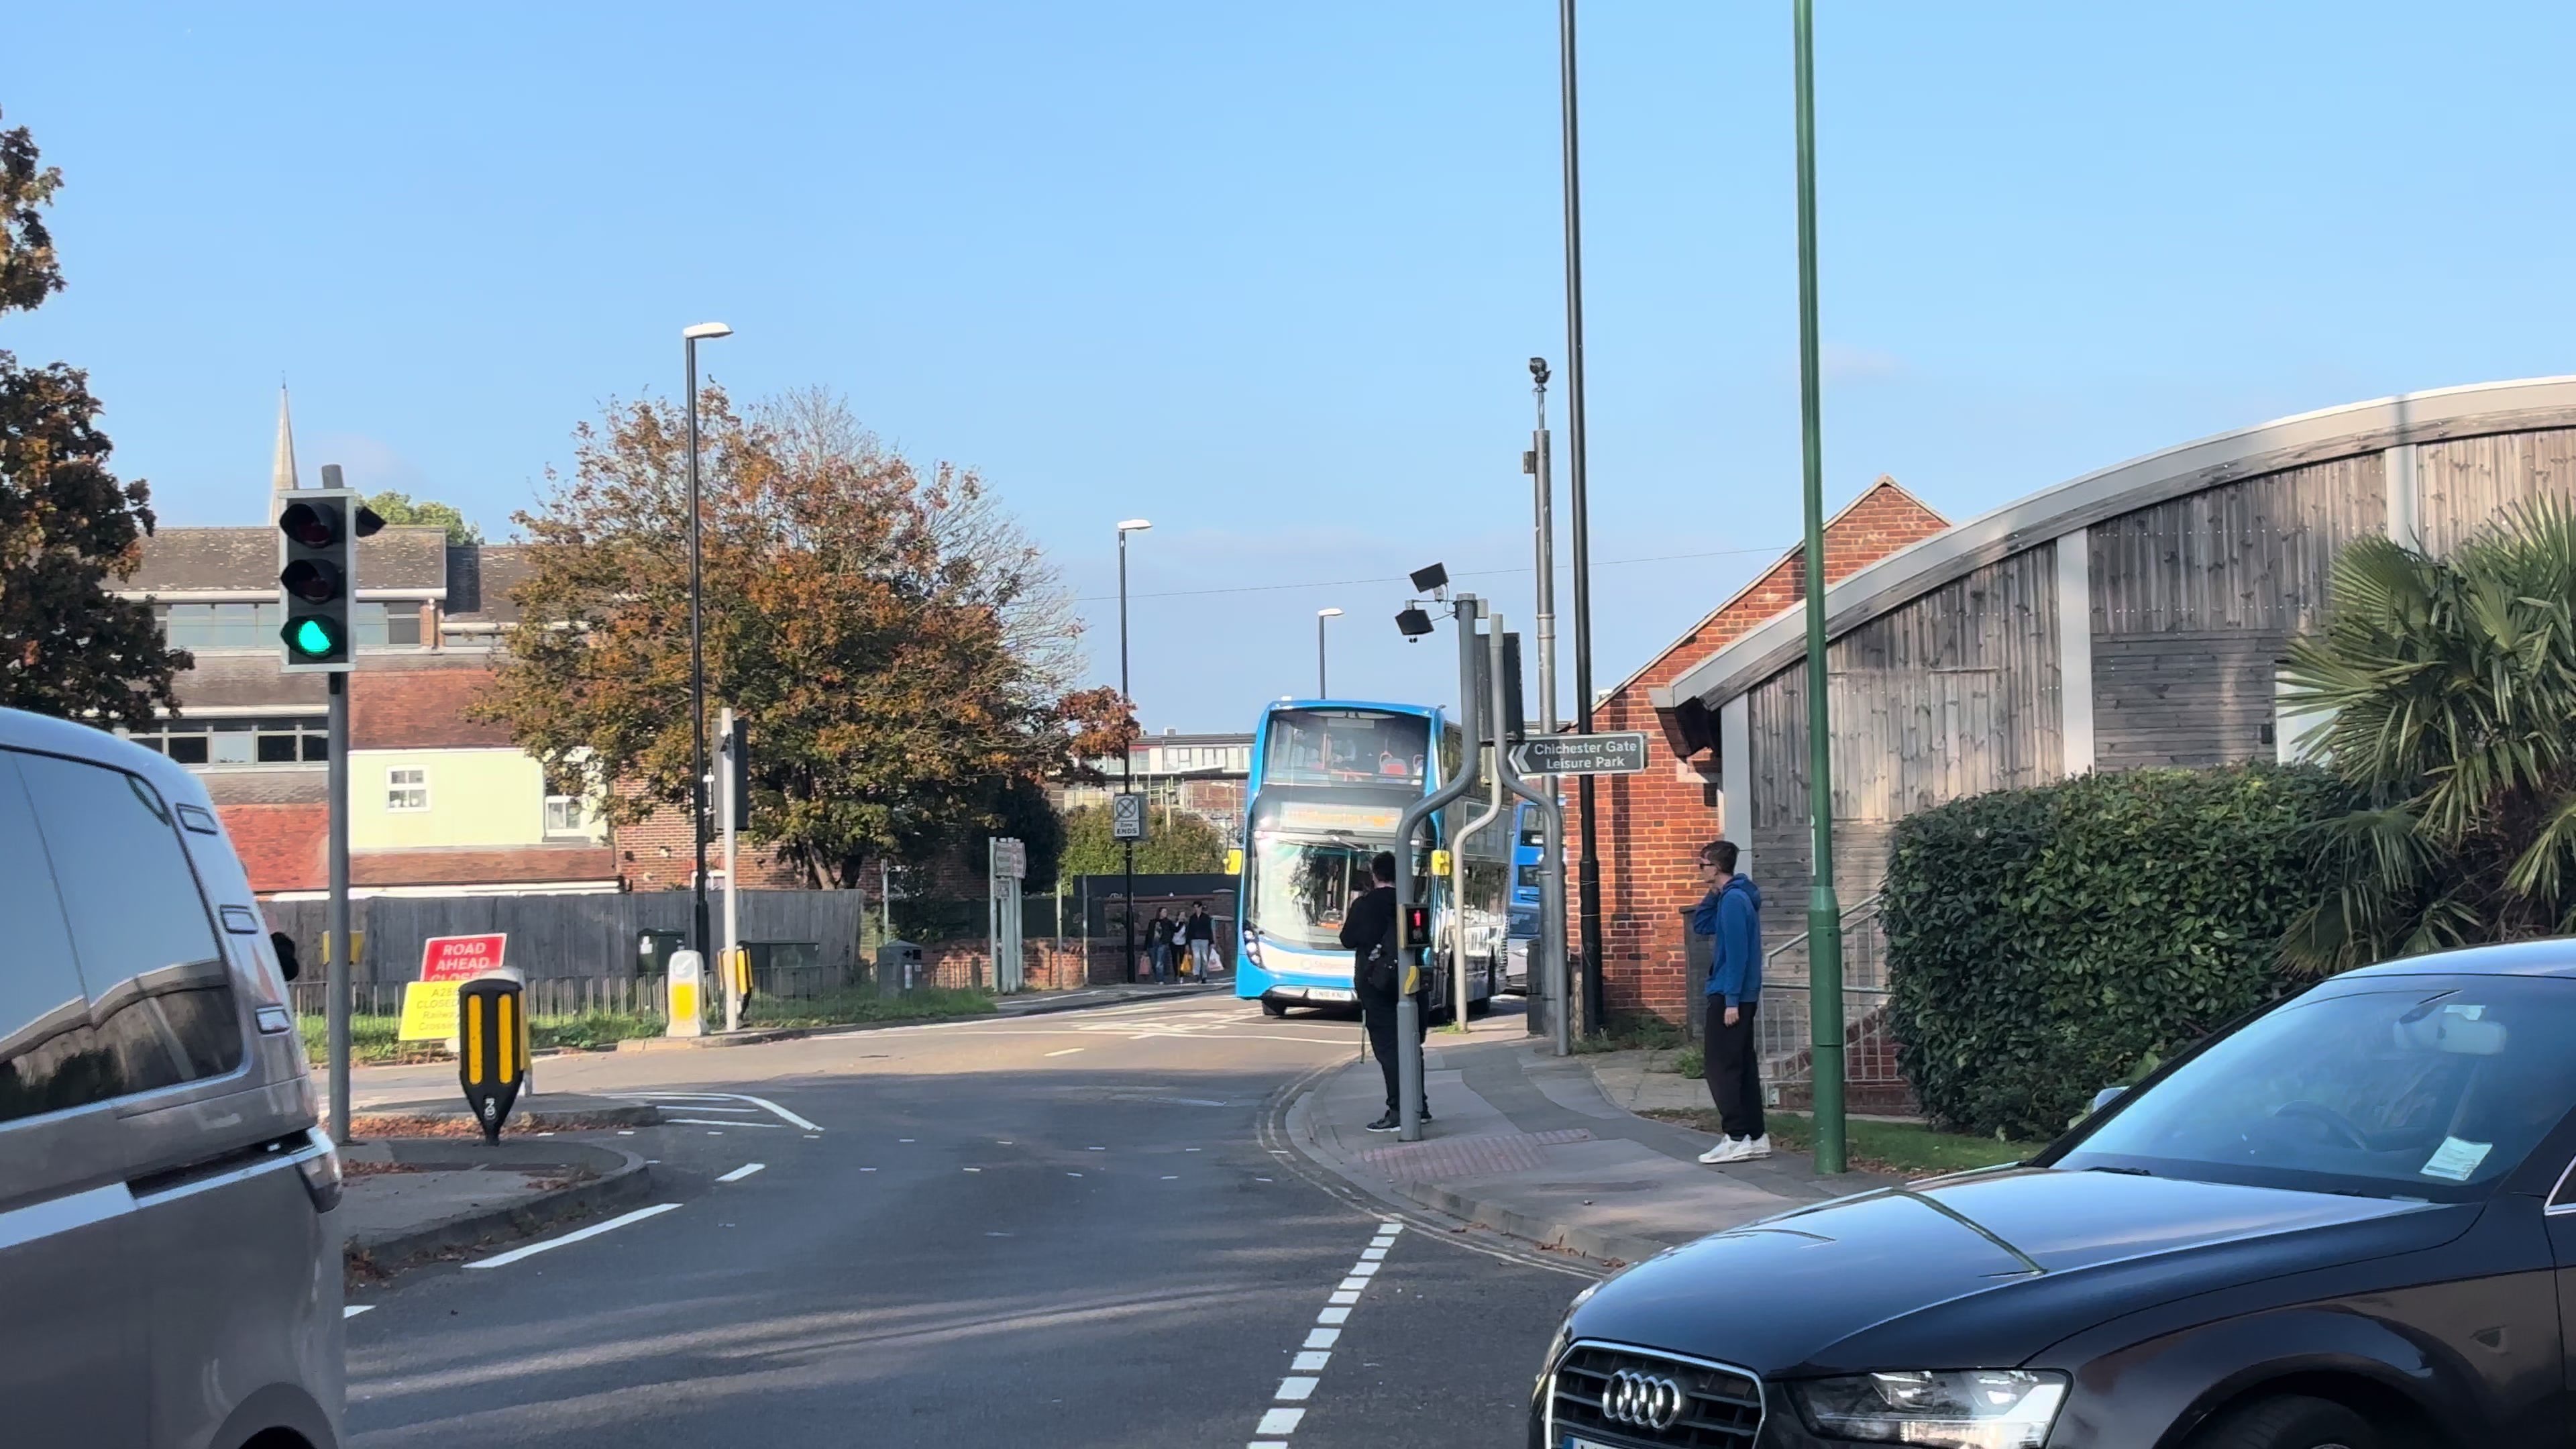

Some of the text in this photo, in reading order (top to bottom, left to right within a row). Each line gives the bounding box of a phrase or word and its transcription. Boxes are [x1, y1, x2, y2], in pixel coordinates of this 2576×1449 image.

[1534, 741, 1638, 755] Chichester Gate
[1546, 755, 1625, 769] Leisure Park
[443, 942, 486, 956] ROAD
[435, 957, 490, 971] AHEAD
